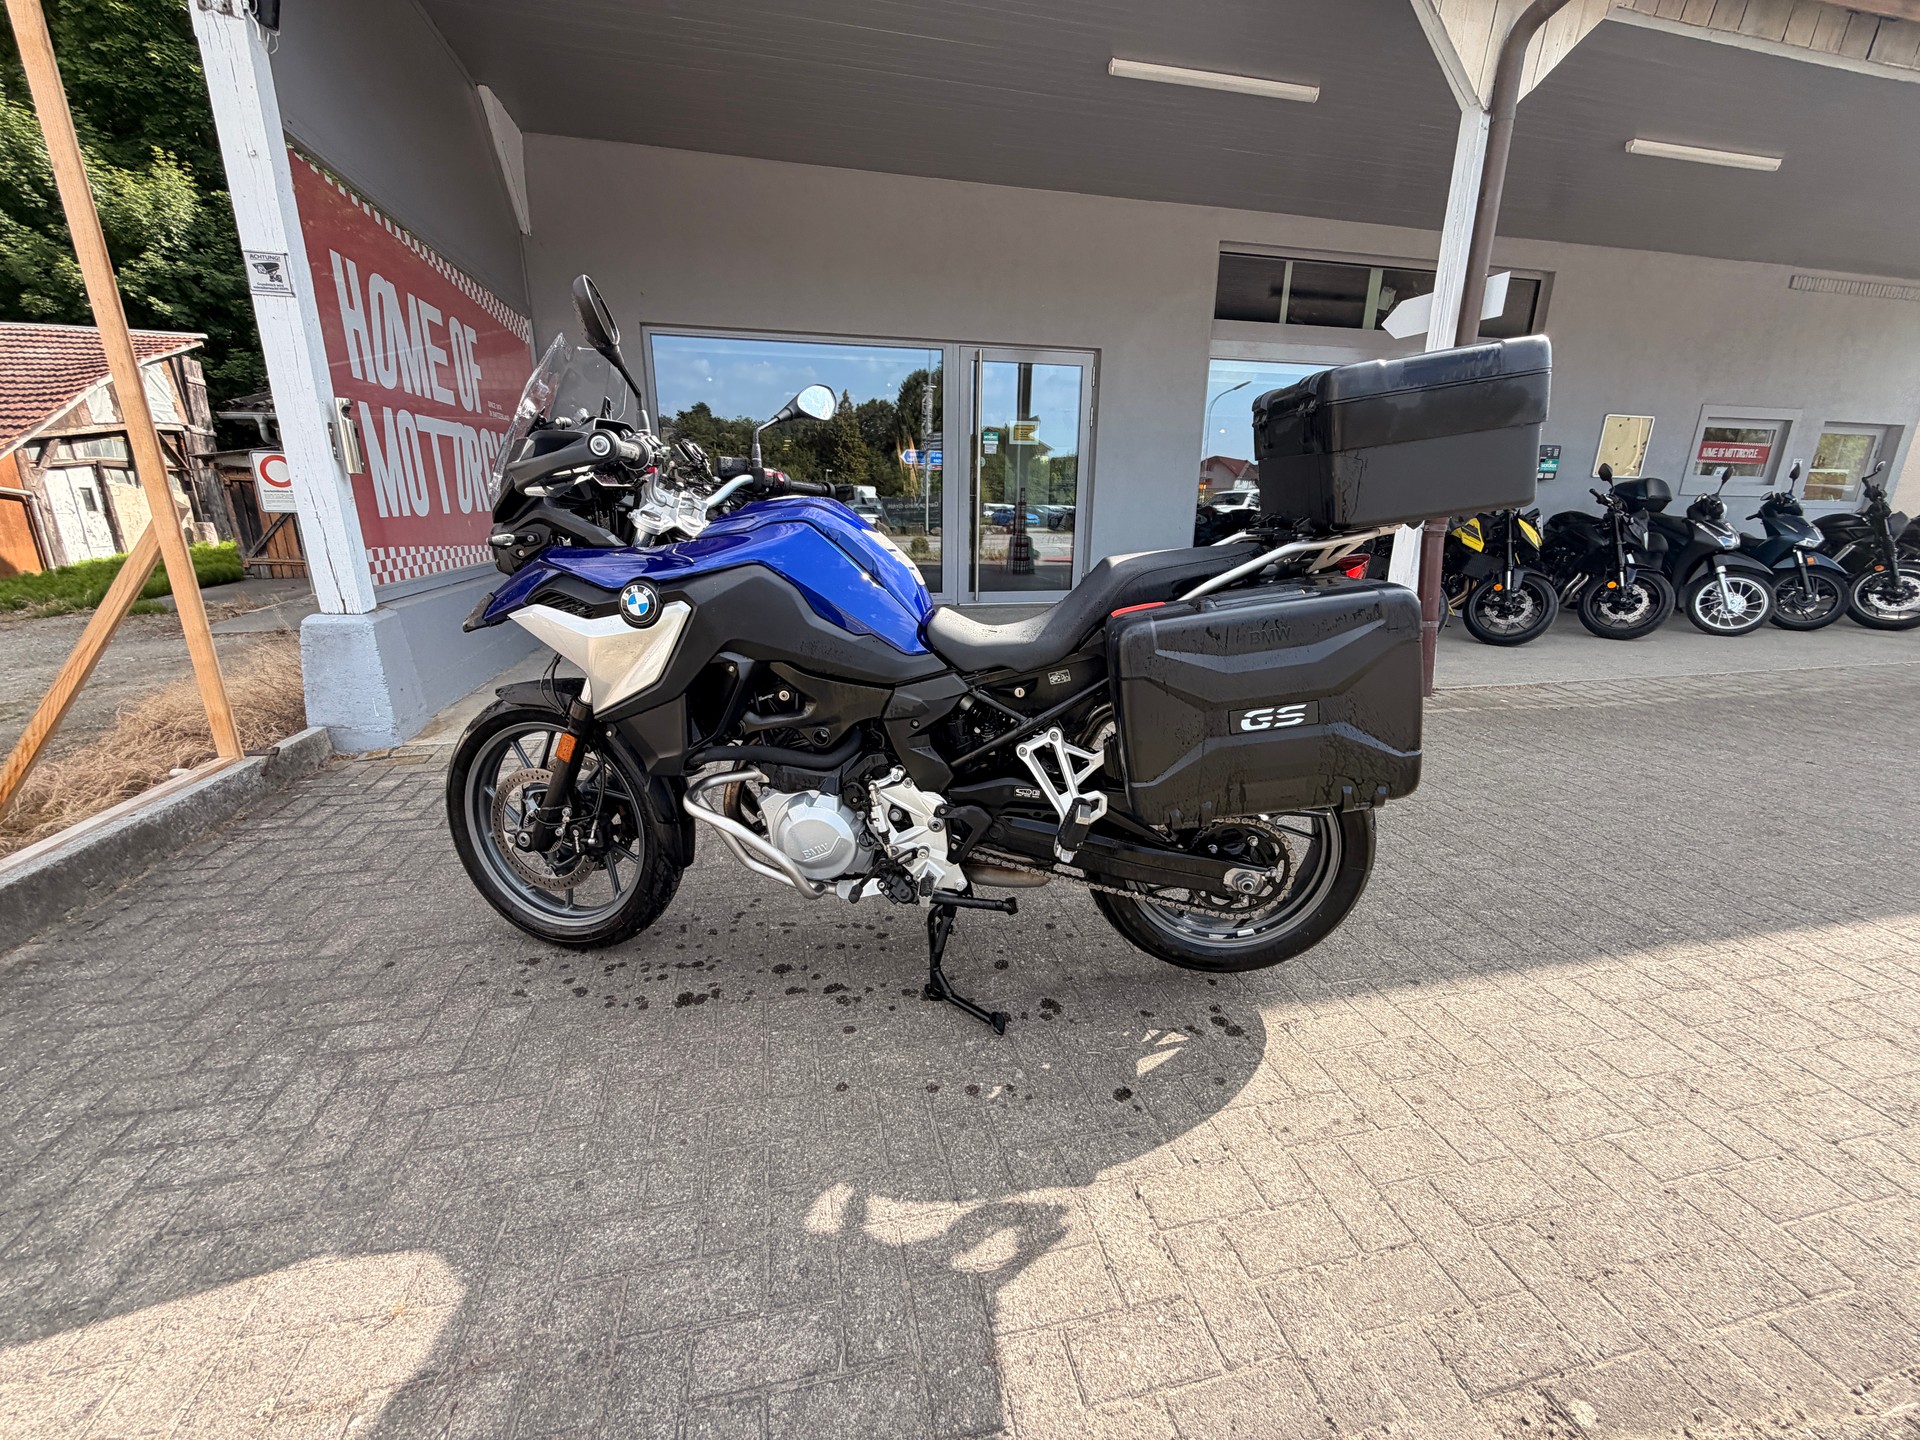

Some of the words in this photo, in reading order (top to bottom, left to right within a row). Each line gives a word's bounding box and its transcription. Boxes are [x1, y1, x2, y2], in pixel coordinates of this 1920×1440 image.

[249, 253, 281, 262] ACHTUNG!
[329, 249, 456, 406] HOME
[449, 316, 482, 414] OF
[622, 585, 651, 601] BMW
[1249, 625, 1292, 645] BMW
[1240, 704, 1308, 731] GS
[801, 842, 828, 859] BMW
